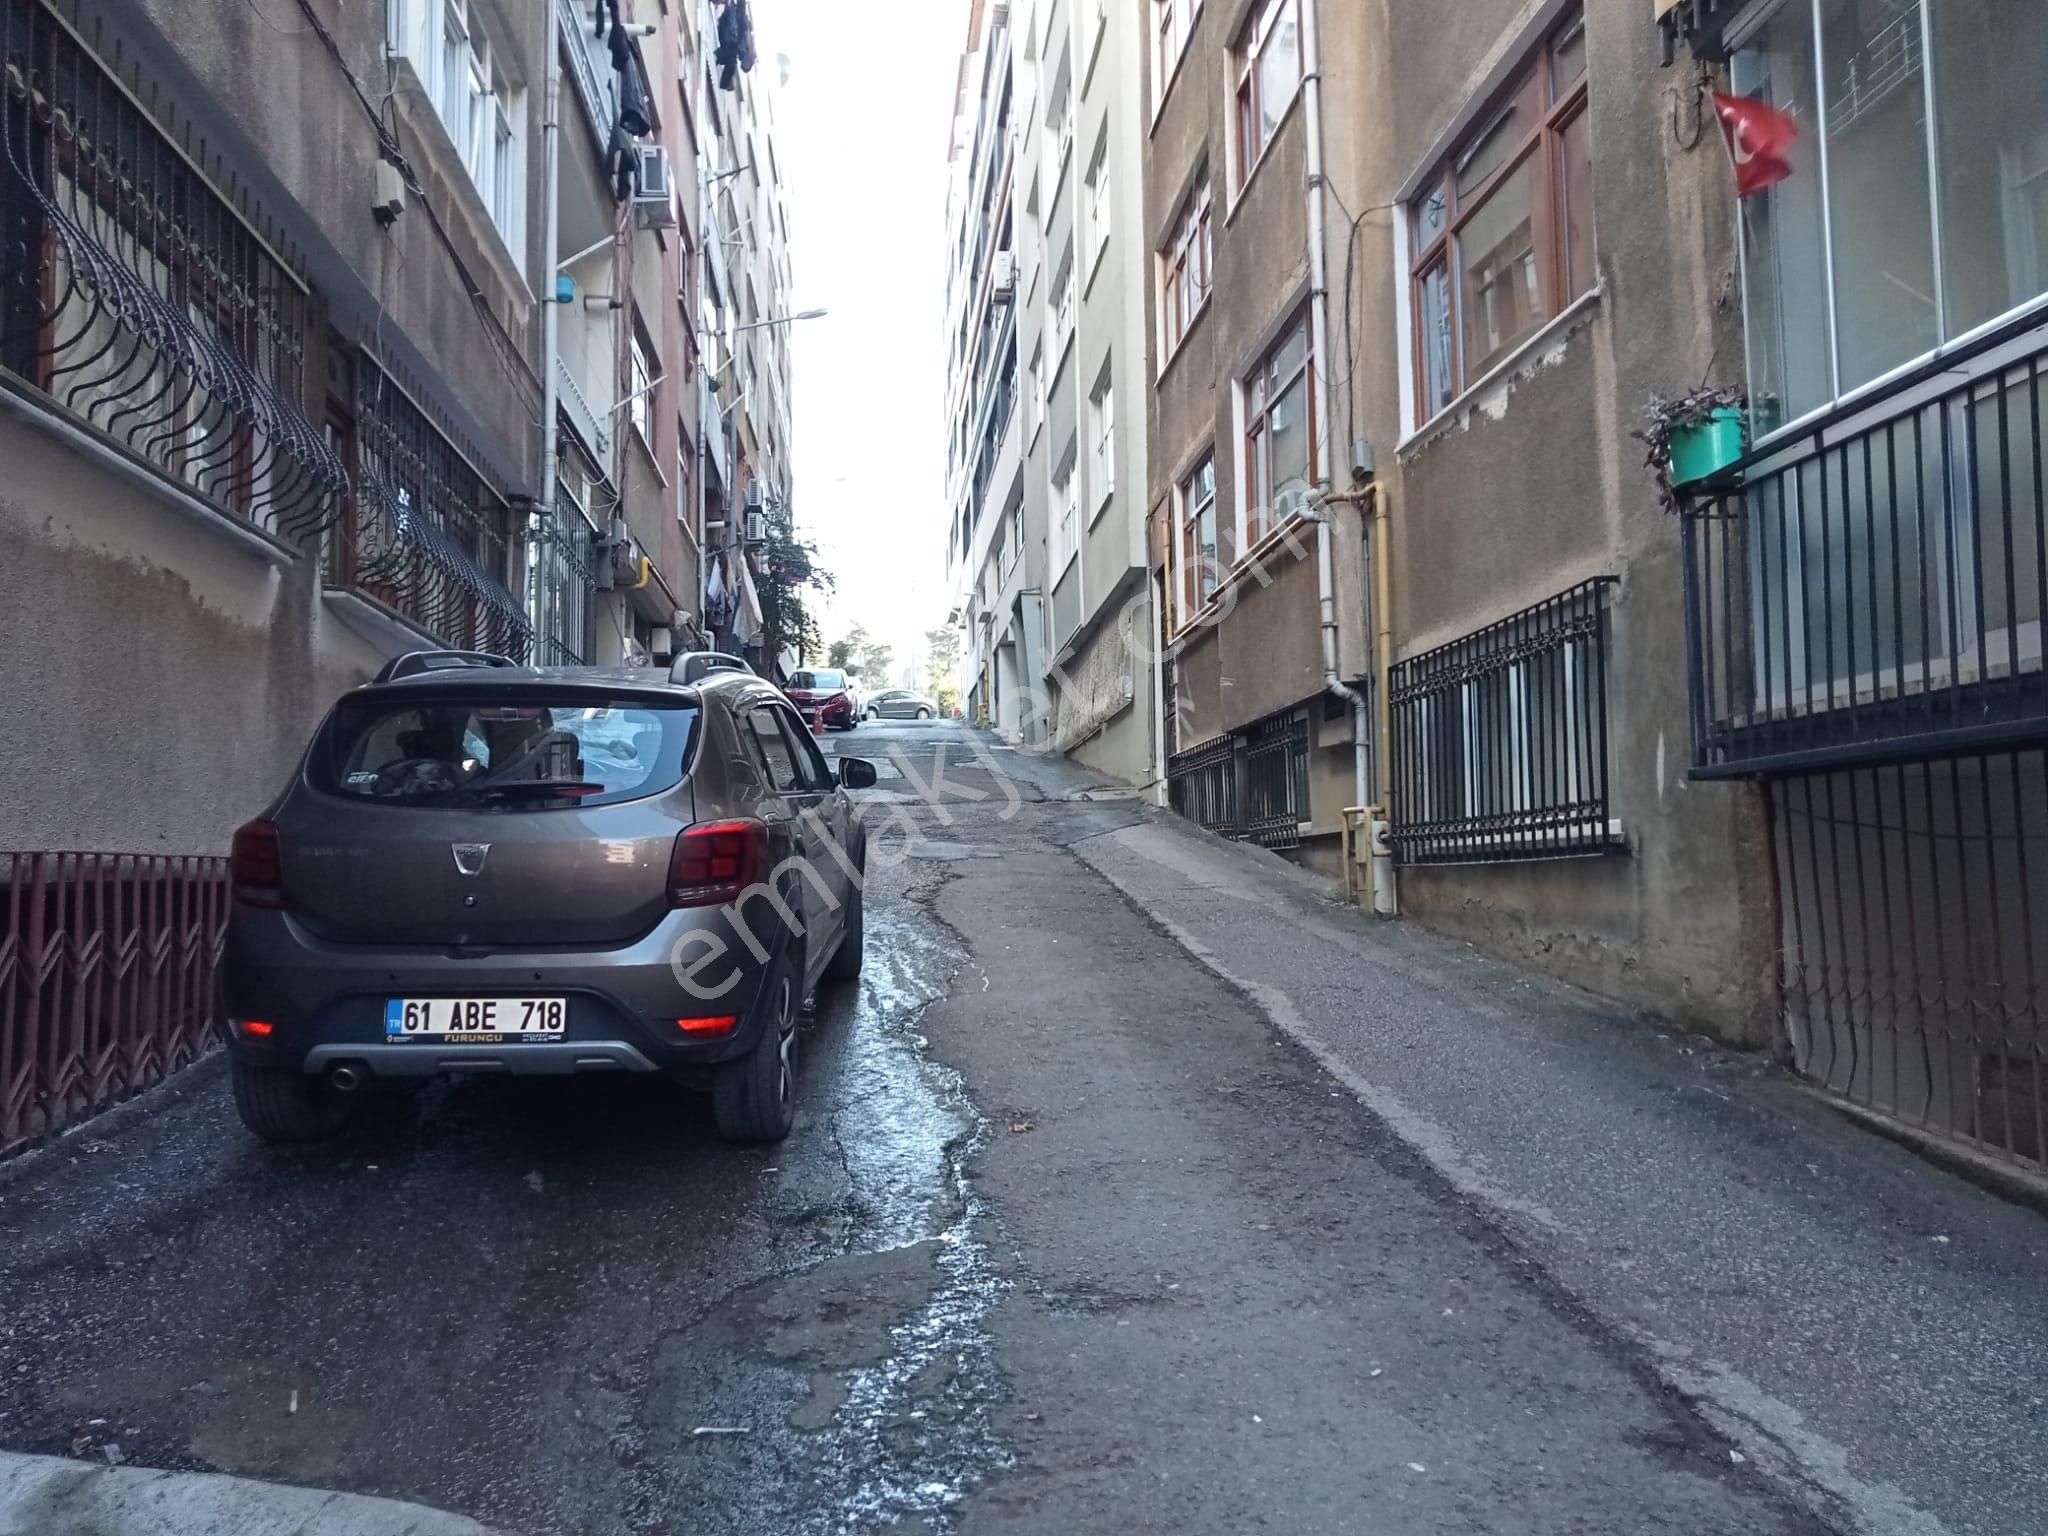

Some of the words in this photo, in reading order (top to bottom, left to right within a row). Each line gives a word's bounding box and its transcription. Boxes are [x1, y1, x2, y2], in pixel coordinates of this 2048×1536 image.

[389, 1019, 401, 1028] TR
[404, 1001, 431, 1031] 61
[449, 1001, 497, 1031] ABE
[520, 1001, 562, 1031] 718
[444, 1033, 504, 1042] FURUNCU
